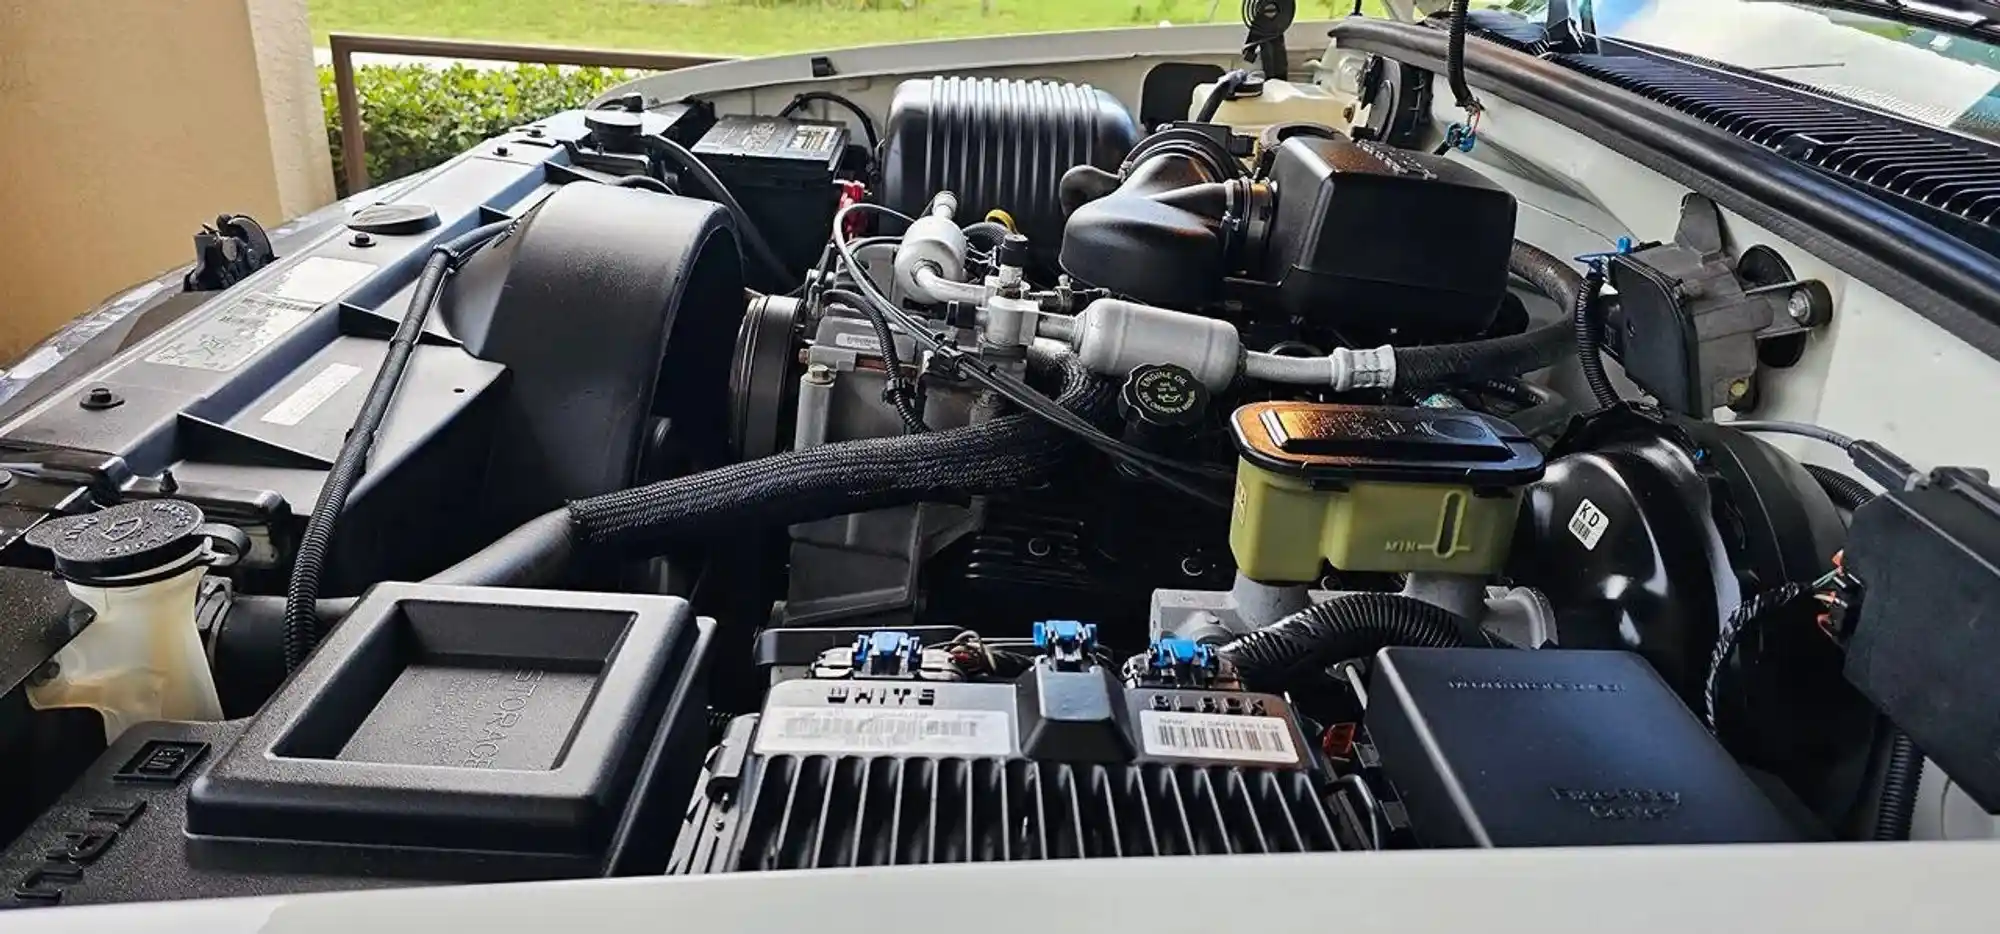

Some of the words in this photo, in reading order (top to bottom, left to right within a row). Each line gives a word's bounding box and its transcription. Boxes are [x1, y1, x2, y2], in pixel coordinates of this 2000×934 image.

[1384, 540, 1417, 552] MIN
[827, 688, 936, 706] WHITE
[1150, 694, 1267, 716] BLACK
